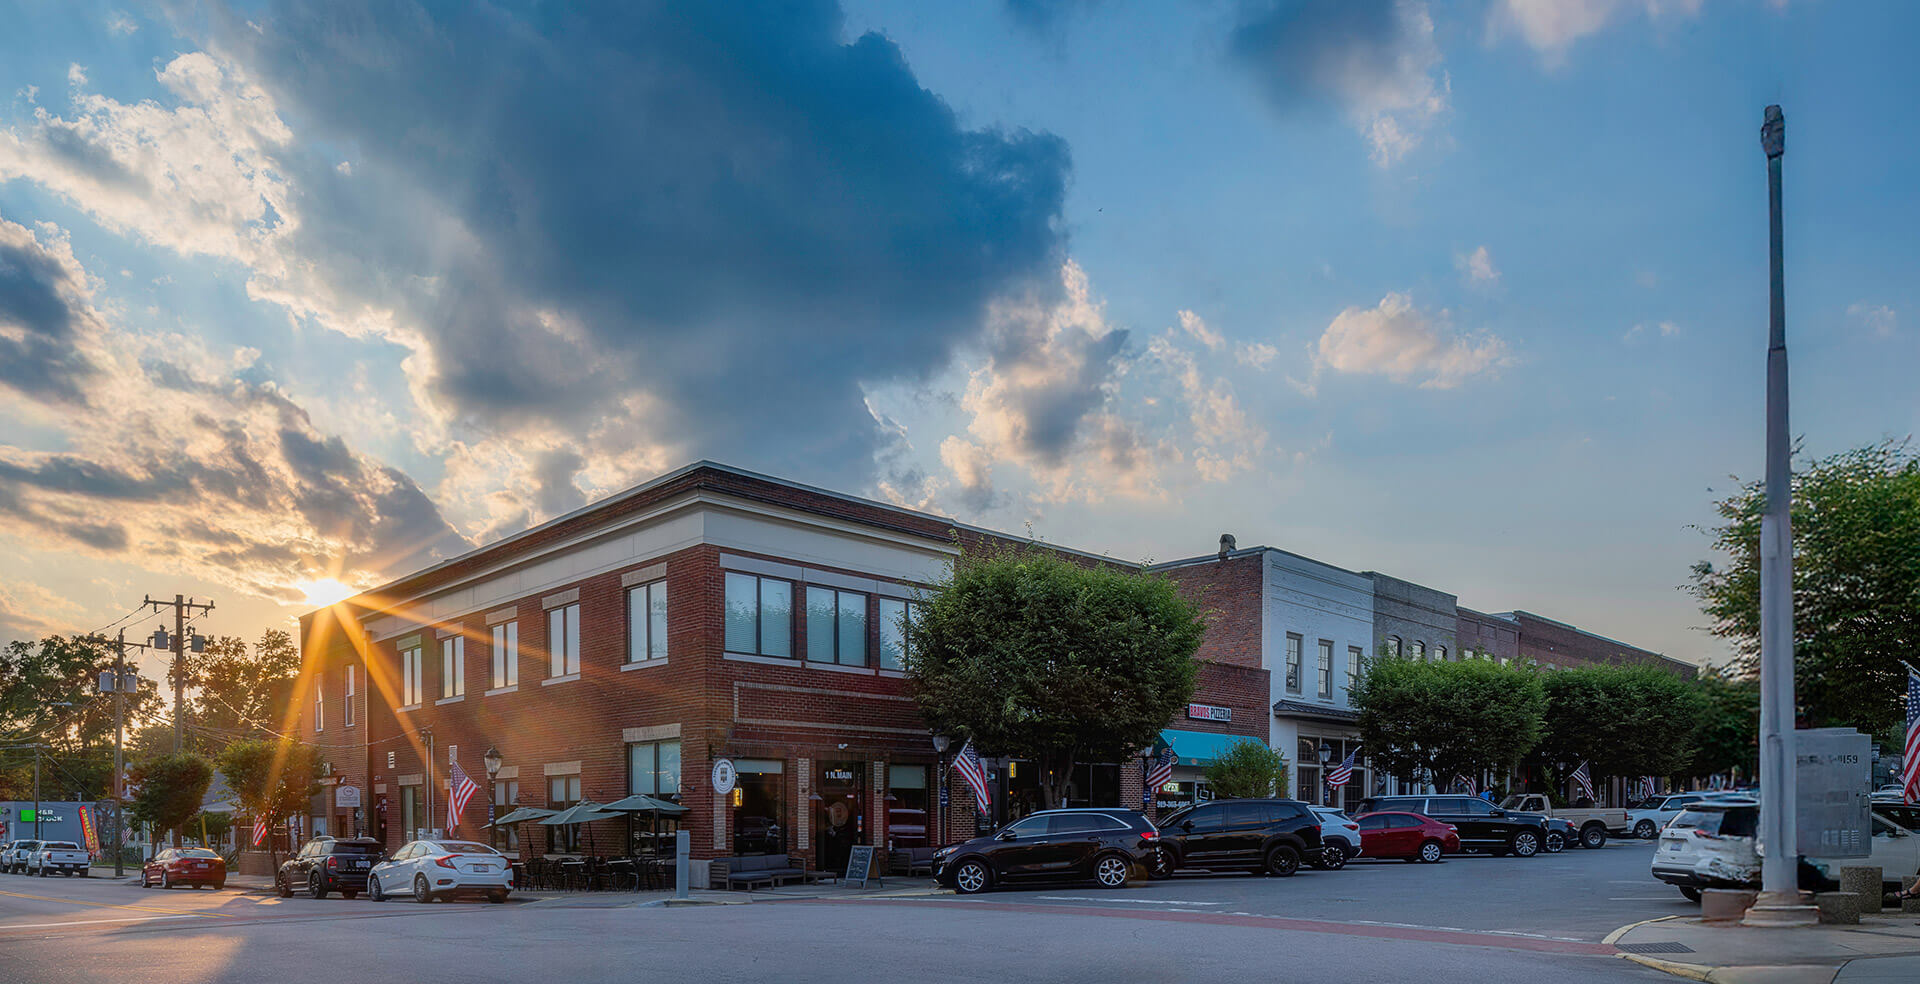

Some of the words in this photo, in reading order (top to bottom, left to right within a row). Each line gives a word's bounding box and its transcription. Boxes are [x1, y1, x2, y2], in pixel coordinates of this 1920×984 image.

[1190, 705, 1210, 719] BRAVOS
[1210, 707, 1230, 720] PIZZERIA
[825, 771, 829, 779] 1
[836, 771, 853, 780] MAIN
[1163, 782, 1180, 792] OPEN
